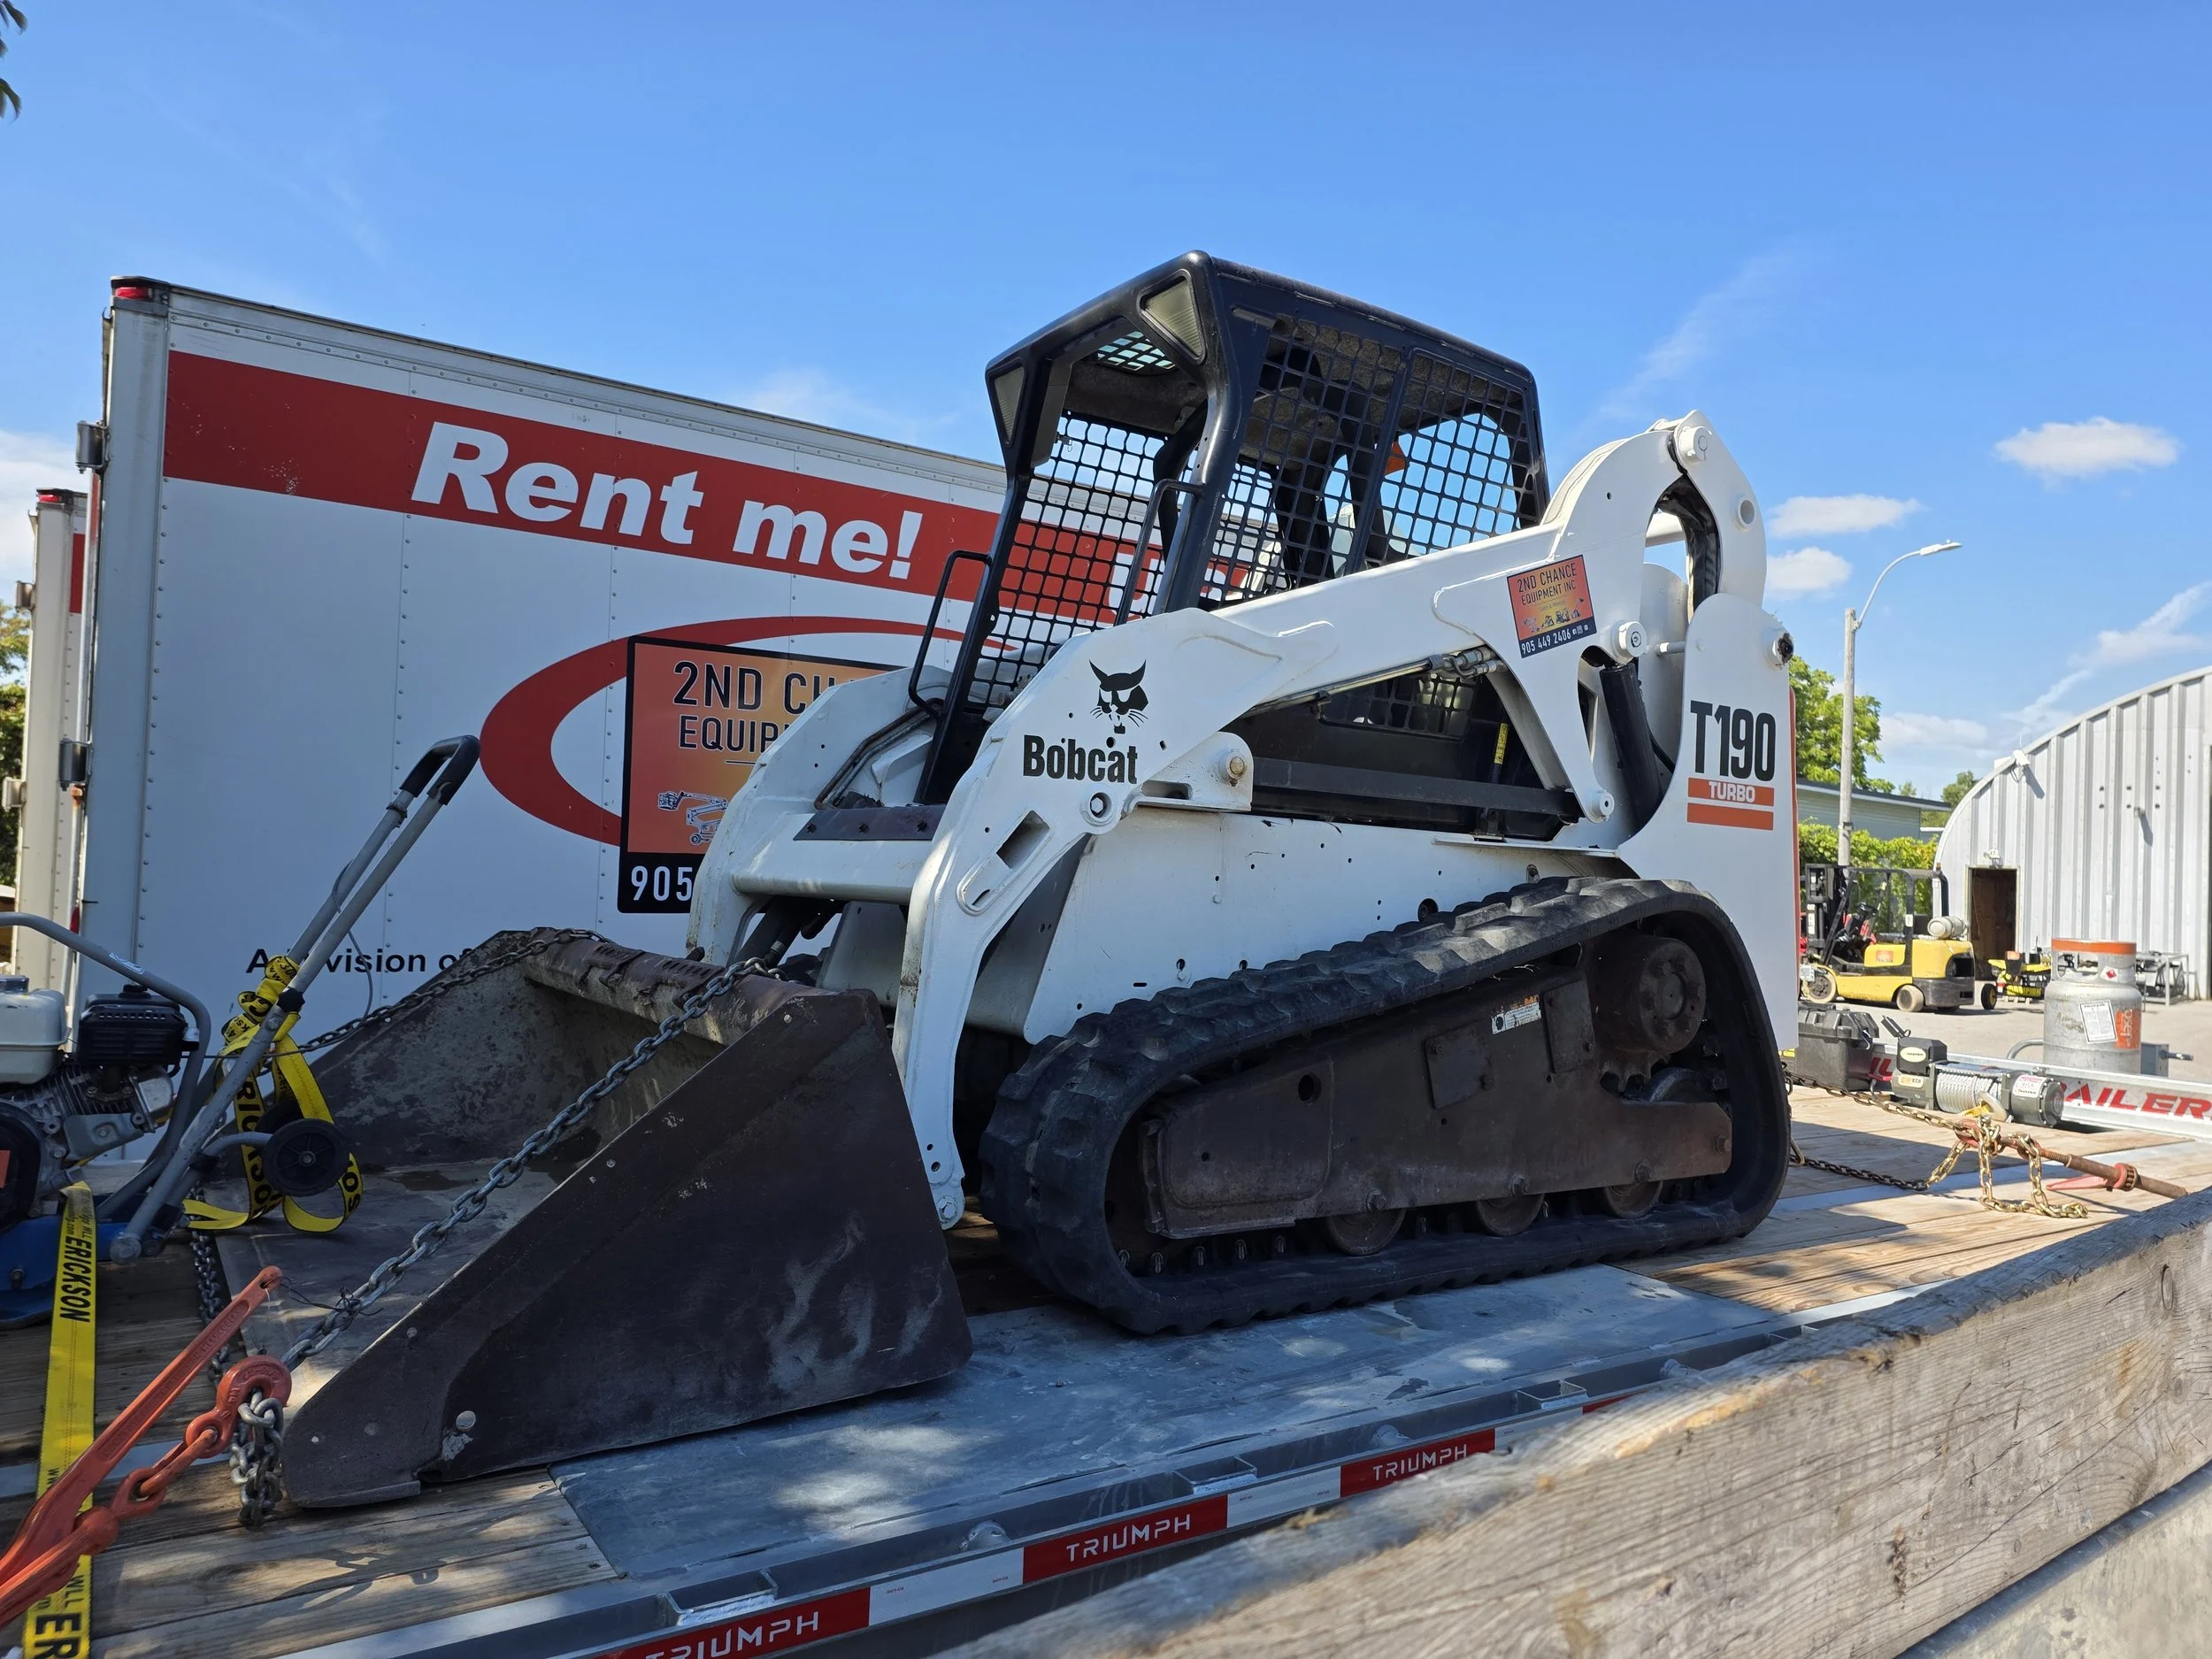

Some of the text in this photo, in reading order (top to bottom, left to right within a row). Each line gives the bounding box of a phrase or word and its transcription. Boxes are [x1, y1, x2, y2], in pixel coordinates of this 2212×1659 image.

[411, 421, 923, 580] Rent me!
[1517, 563, 1578, 593] 2ND CHANCE
[1522, 584, 1563, 605] EQUIPMENT
[1522, 628, 1571, 655] 905 449 2406
[673, 662, 762, 710] 2ND
[679, 714, 790, 753] EQUIP
[1690, 700, 1777, 782] T190
[1023, 734, 1138, 785] Bobcat
[1709, 780, 1756, 803] TURBO
[631, 865, 695, 902] 905
[60, 1236, 93, 1323] ERICKSON
[1372, 1443, 1467, 1481] TRIUMPH
[1066, 1514, 1191, 1563] TRIUMPH
